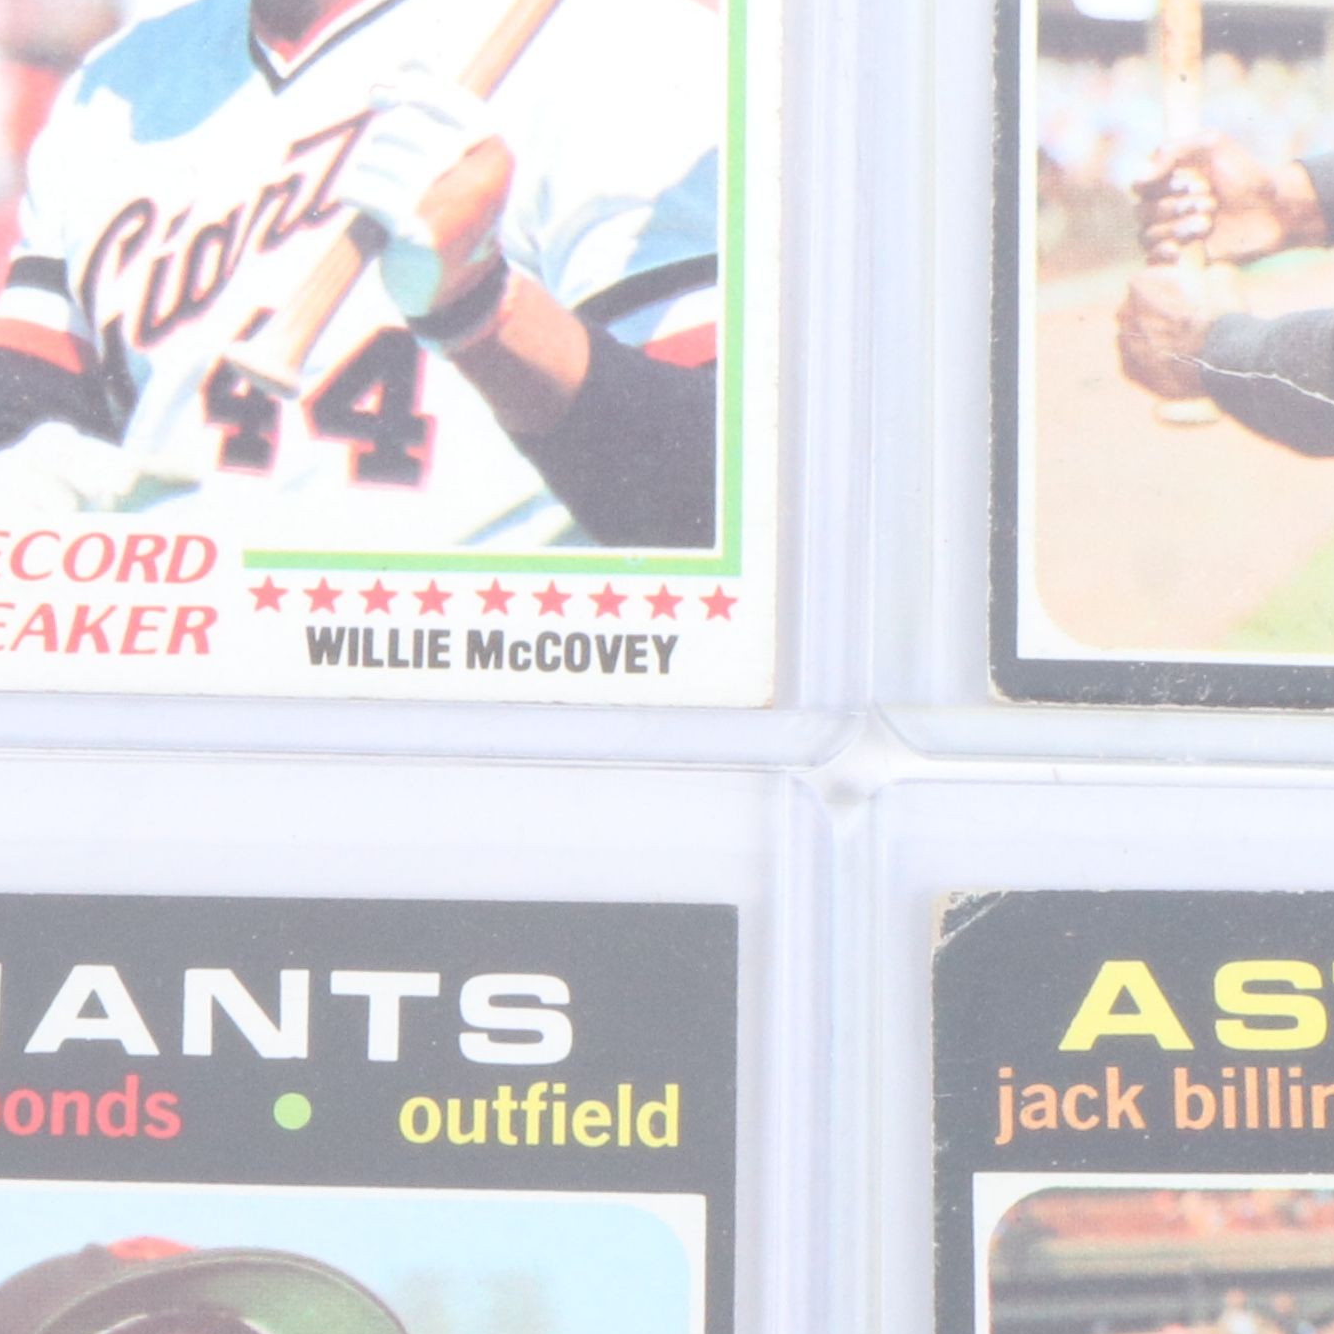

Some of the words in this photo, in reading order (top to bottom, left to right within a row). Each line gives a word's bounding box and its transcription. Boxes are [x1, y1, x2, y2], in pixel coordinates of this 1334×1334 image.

[306, 626, 450, 669] WILLIE
[466, 630, 678, 675] McCOVEY
[399, 1081, 679, 1147] outfield
[995, 1067, 1146, 1145] jack
